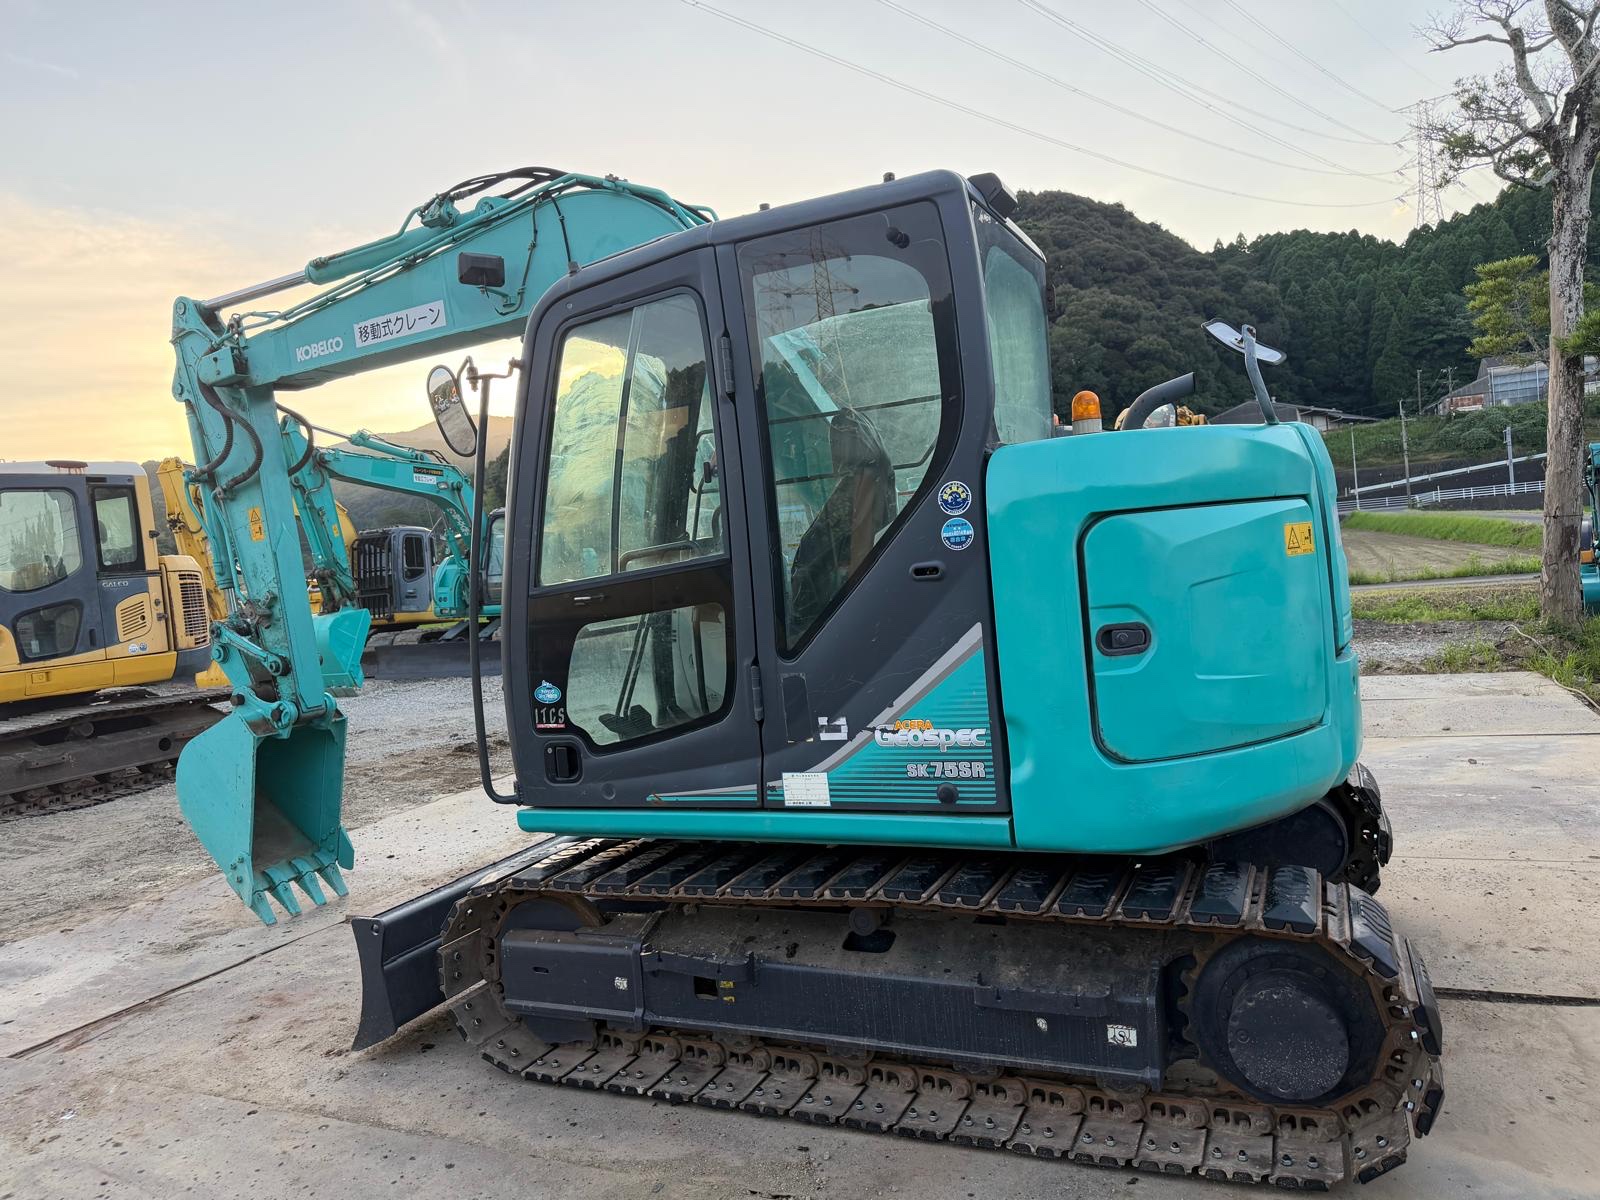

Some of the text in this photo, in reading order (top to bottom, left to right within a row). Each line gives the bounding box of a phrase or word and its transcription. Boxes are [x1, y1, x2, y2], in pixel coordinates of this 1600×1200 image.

[358, 307, 441, 344] 移動式クレーン
[296, 336, 344, 363] KOBELCO
[535, 706, 565, 724] ITCS
[894, 719, 933, 731] ACERA
